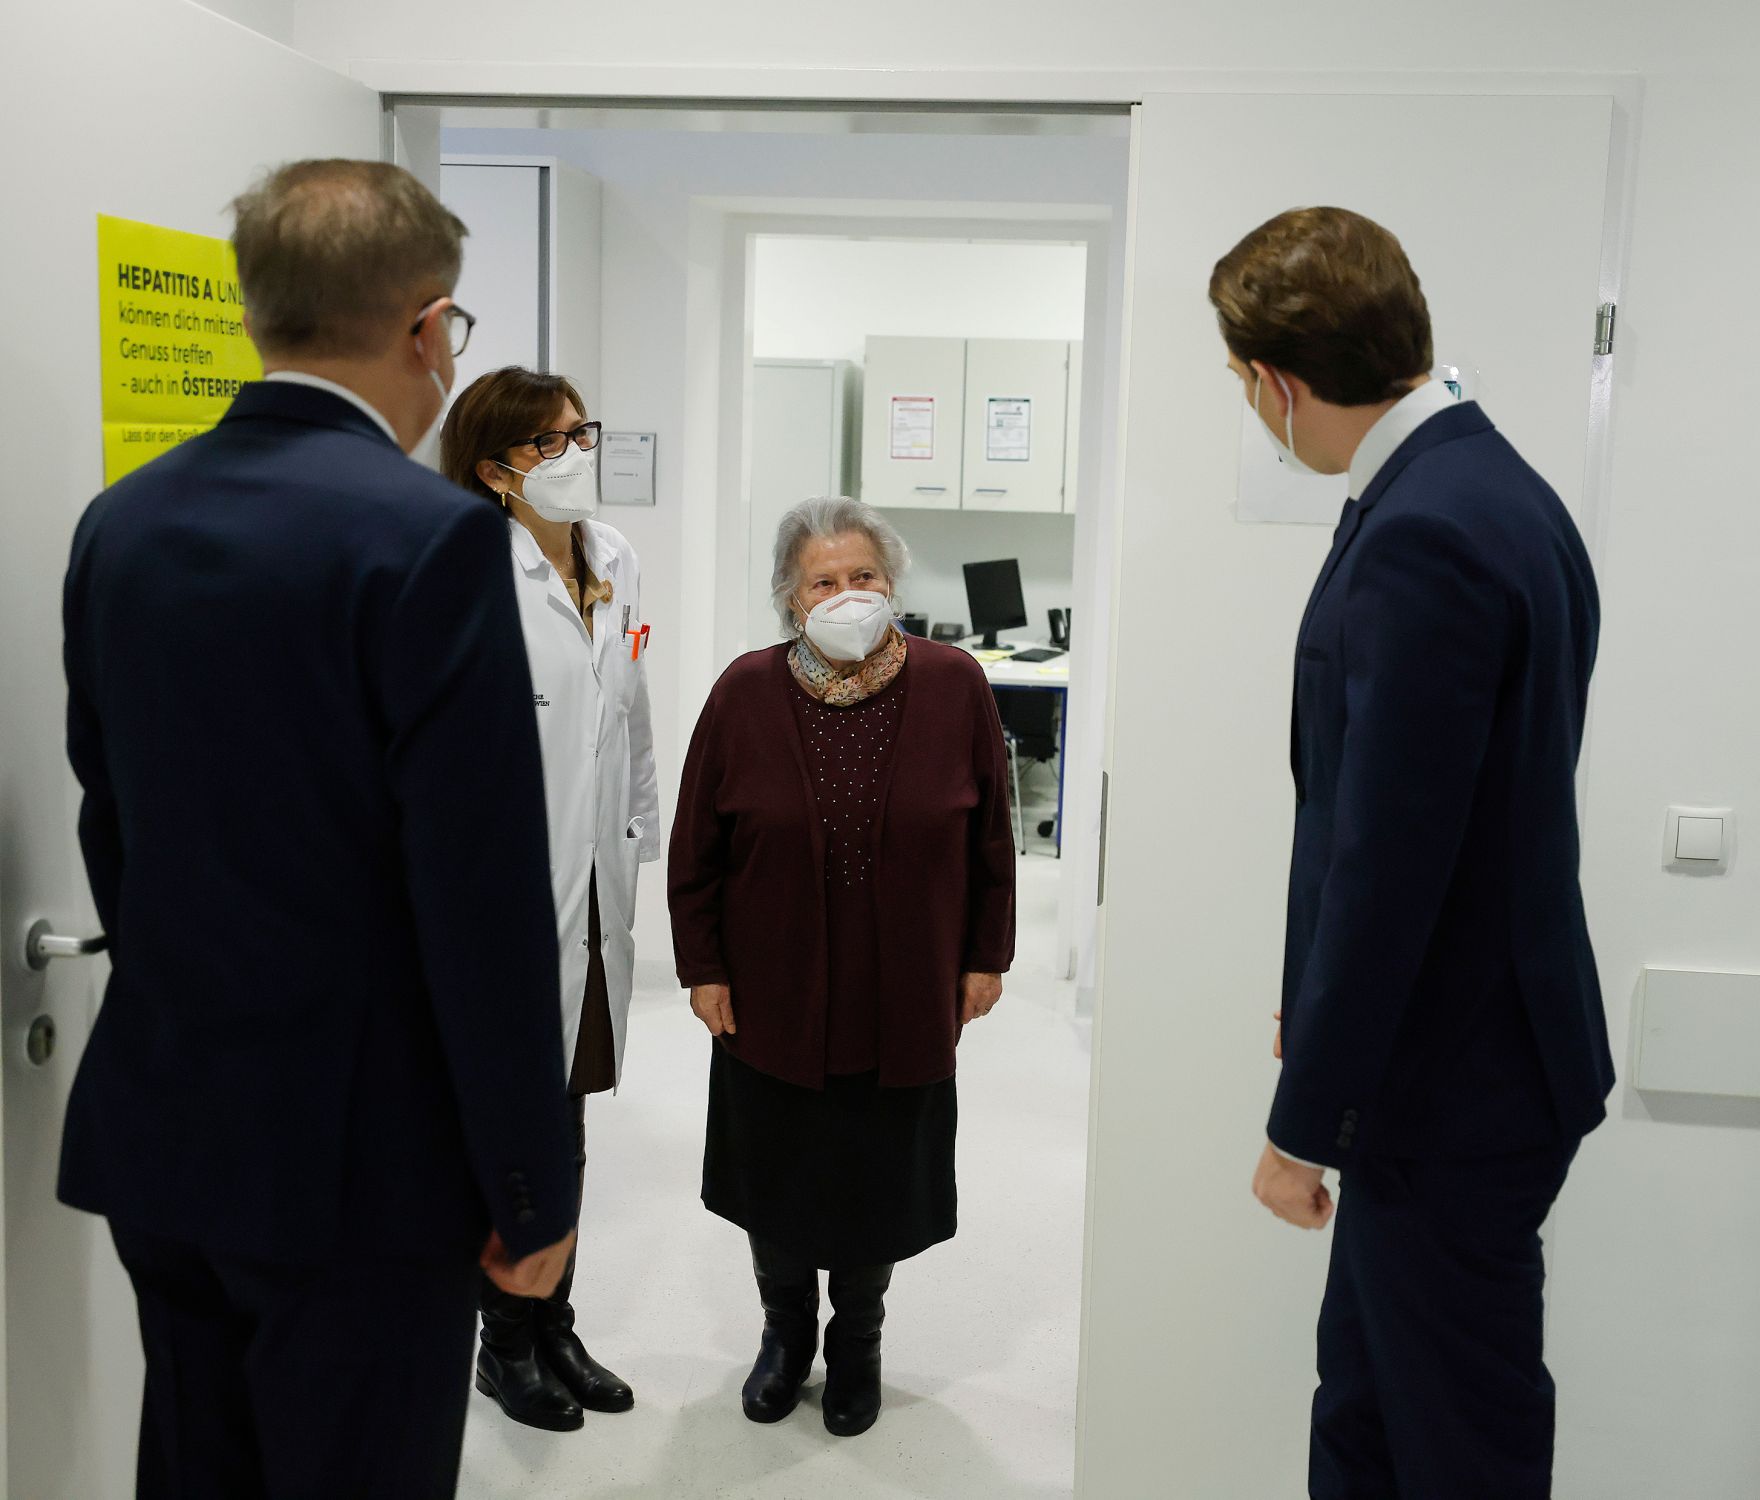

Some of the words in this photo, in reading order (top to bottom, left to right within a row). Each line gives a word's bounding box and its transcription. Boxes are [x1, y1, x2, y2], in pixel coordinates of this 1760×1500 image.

[118, 263, 199, 298] HEPATITIS
[203, 277, 214, 300] A
[119, 300, 171, 328] können
[174, 308, 201, 332] dich
[204, 314, 243, 337] mitten
[120, 337, 169, 362] Genuss
[172, 343, 213, 365] treffen
[131, 373, 163, 394] auch
[167, 373, 179, 395] in
